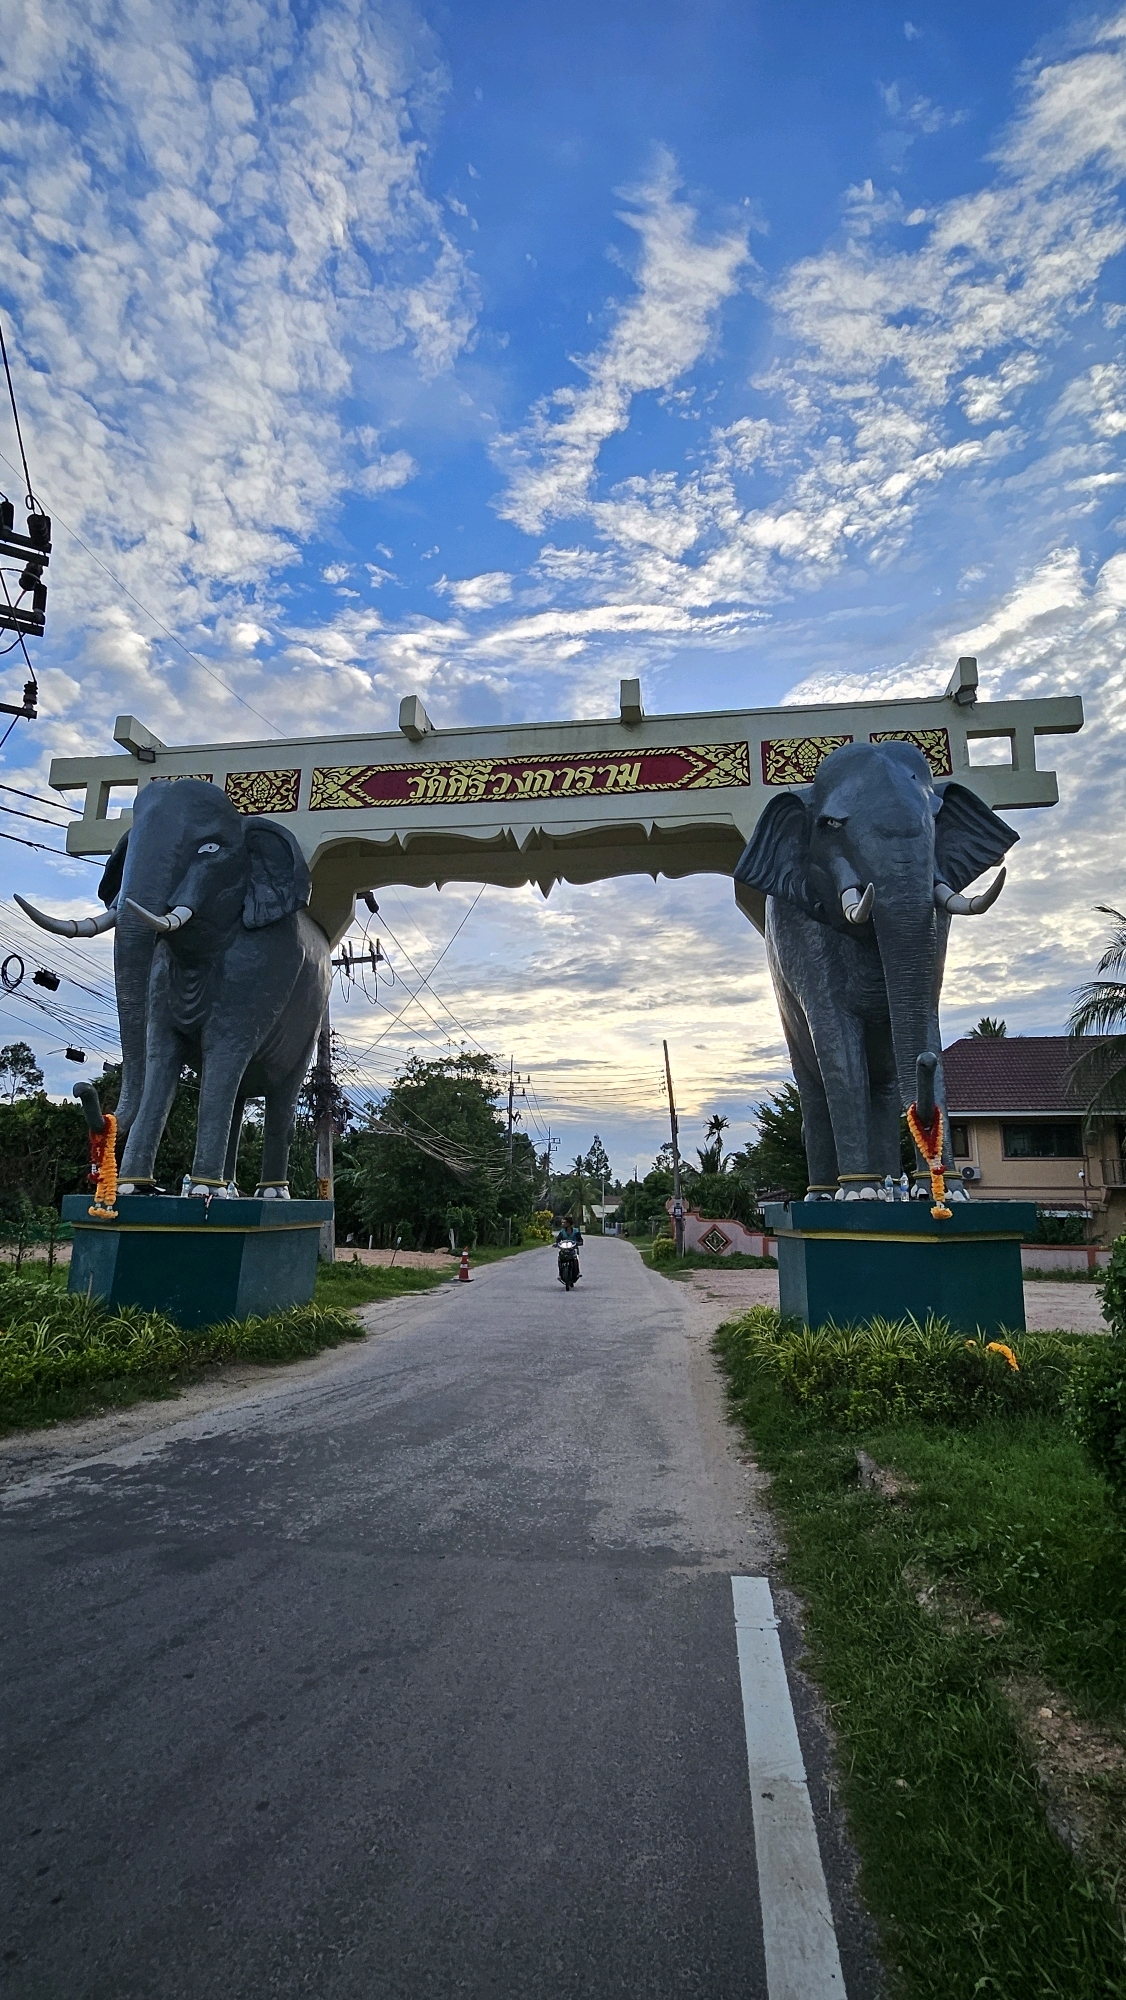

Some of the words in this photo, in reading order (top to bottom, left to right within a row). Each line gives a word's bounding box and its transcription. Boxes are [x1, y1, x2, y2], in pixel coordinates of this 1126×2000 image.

[407, 764, 642, 798] วัดคีรีวงการาม
